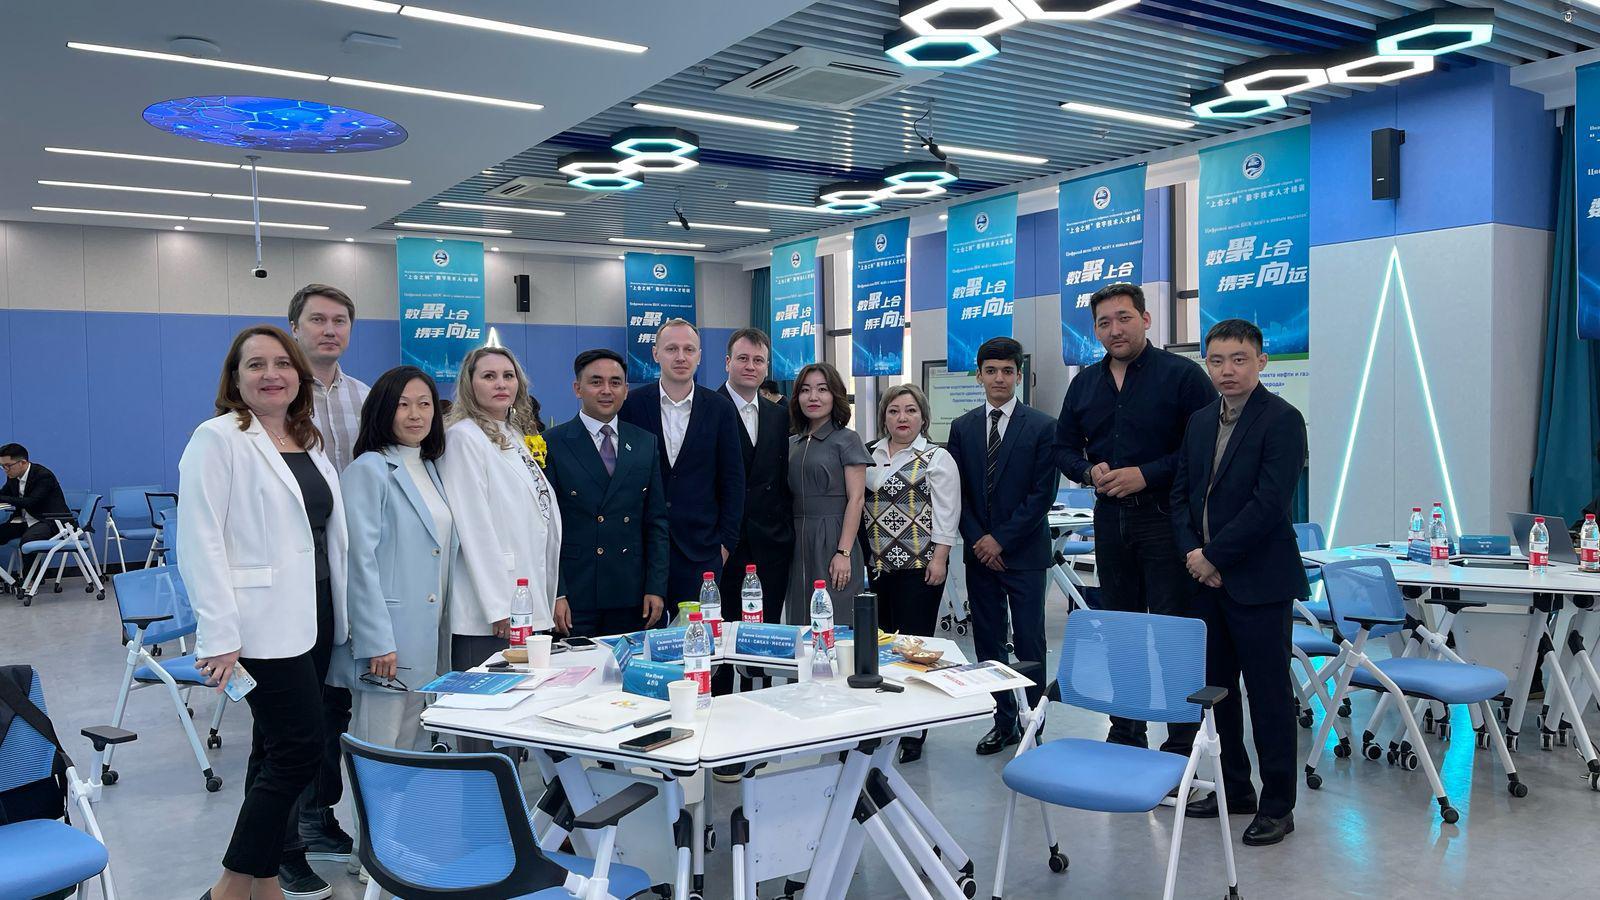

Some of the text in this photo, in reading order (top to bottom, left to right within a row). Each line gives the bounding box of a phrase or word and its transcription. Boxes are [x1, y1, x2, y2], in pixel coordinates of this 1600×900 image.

[1205, 236, 1293, 266] 数聚上合
[1065, 259, 1134, 285] 数聚上合
[1217, 261, 1308, 292] 携手向远
[952, 277, 1007, 299] 数聚上合
[405, 303, 470, 320] 数聚上合
[857, 292, 902, 311] 数聚上合
[961, 297, 1014, 320] 携手向远
[630, 312, 683, 326] 数聚
[414, 322, 480, 339] 携手向远
